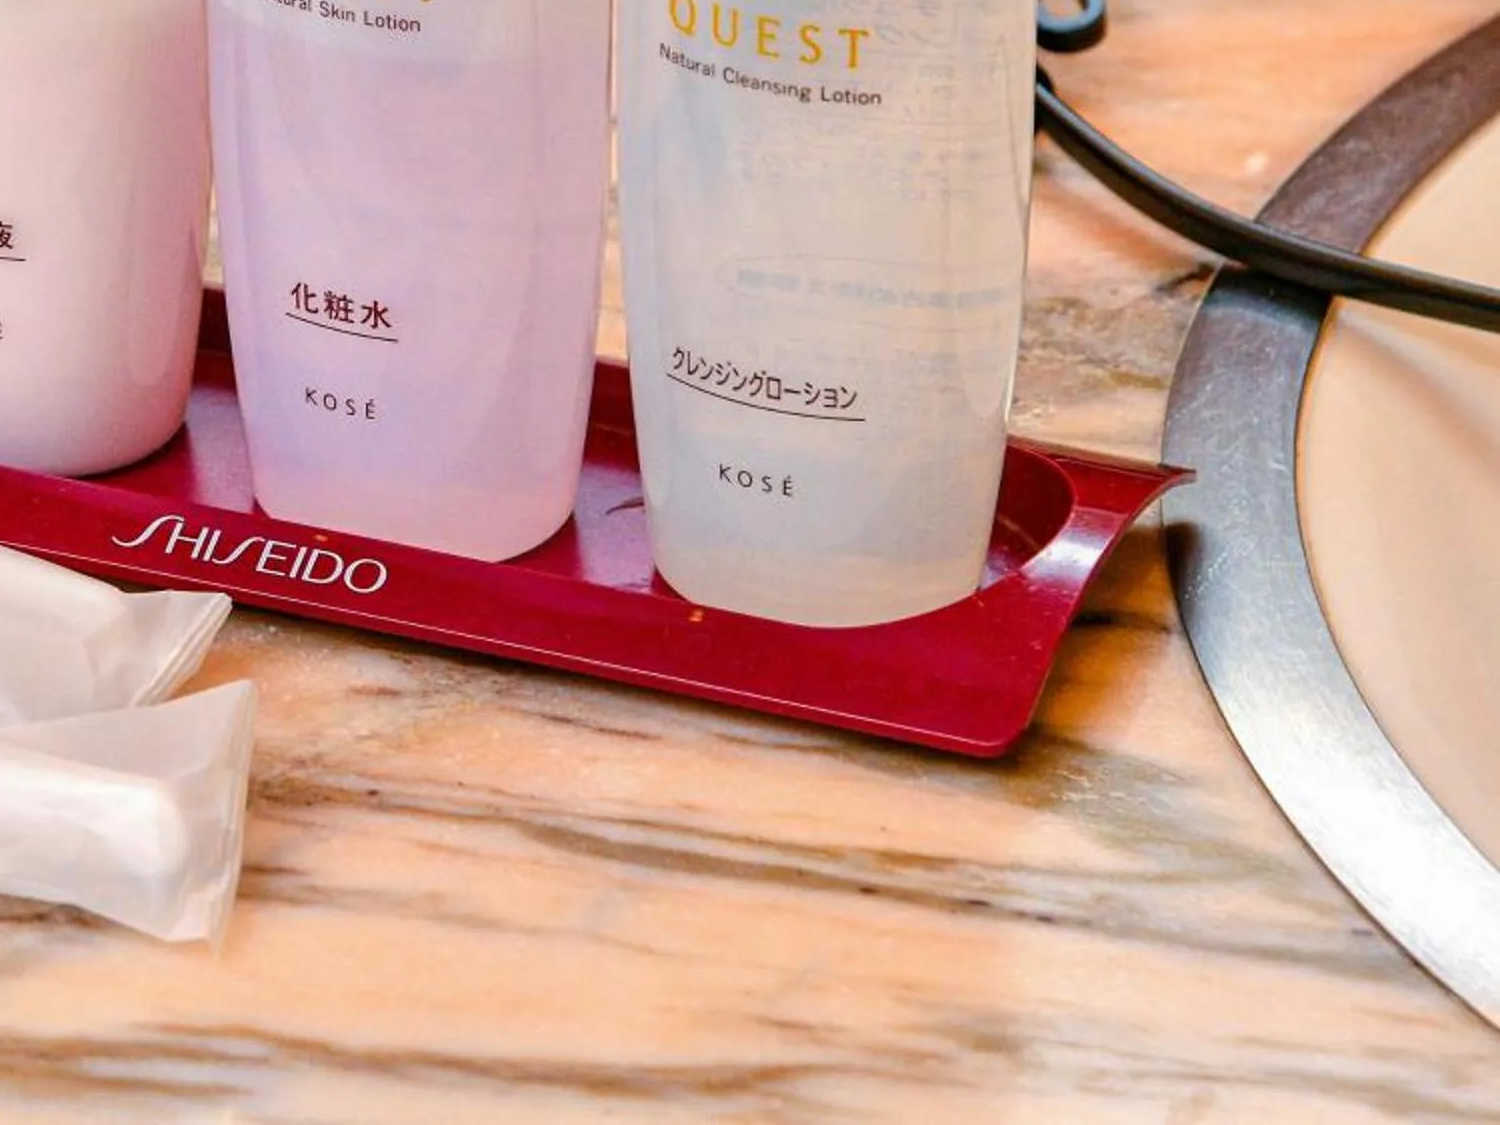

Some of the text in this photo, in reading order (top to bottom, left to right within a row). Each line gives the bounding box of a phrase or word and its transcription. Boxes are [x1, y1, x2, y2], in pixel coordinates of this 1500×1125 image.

[319, 1, 357, 23] Skin
[363, 10, 421, 33] Lotion
[659, 42, 882, 106] Natural Cleansing Lotion
[291, 282, 392, 329] 化粧水
[672, 347, 858, 409] クレンジングローション
[305, 386, 376, 420] KOSÉ
[718, 463, 793, 496] KOSÉ
[111, 514, 388, 594] SHISEIDO
